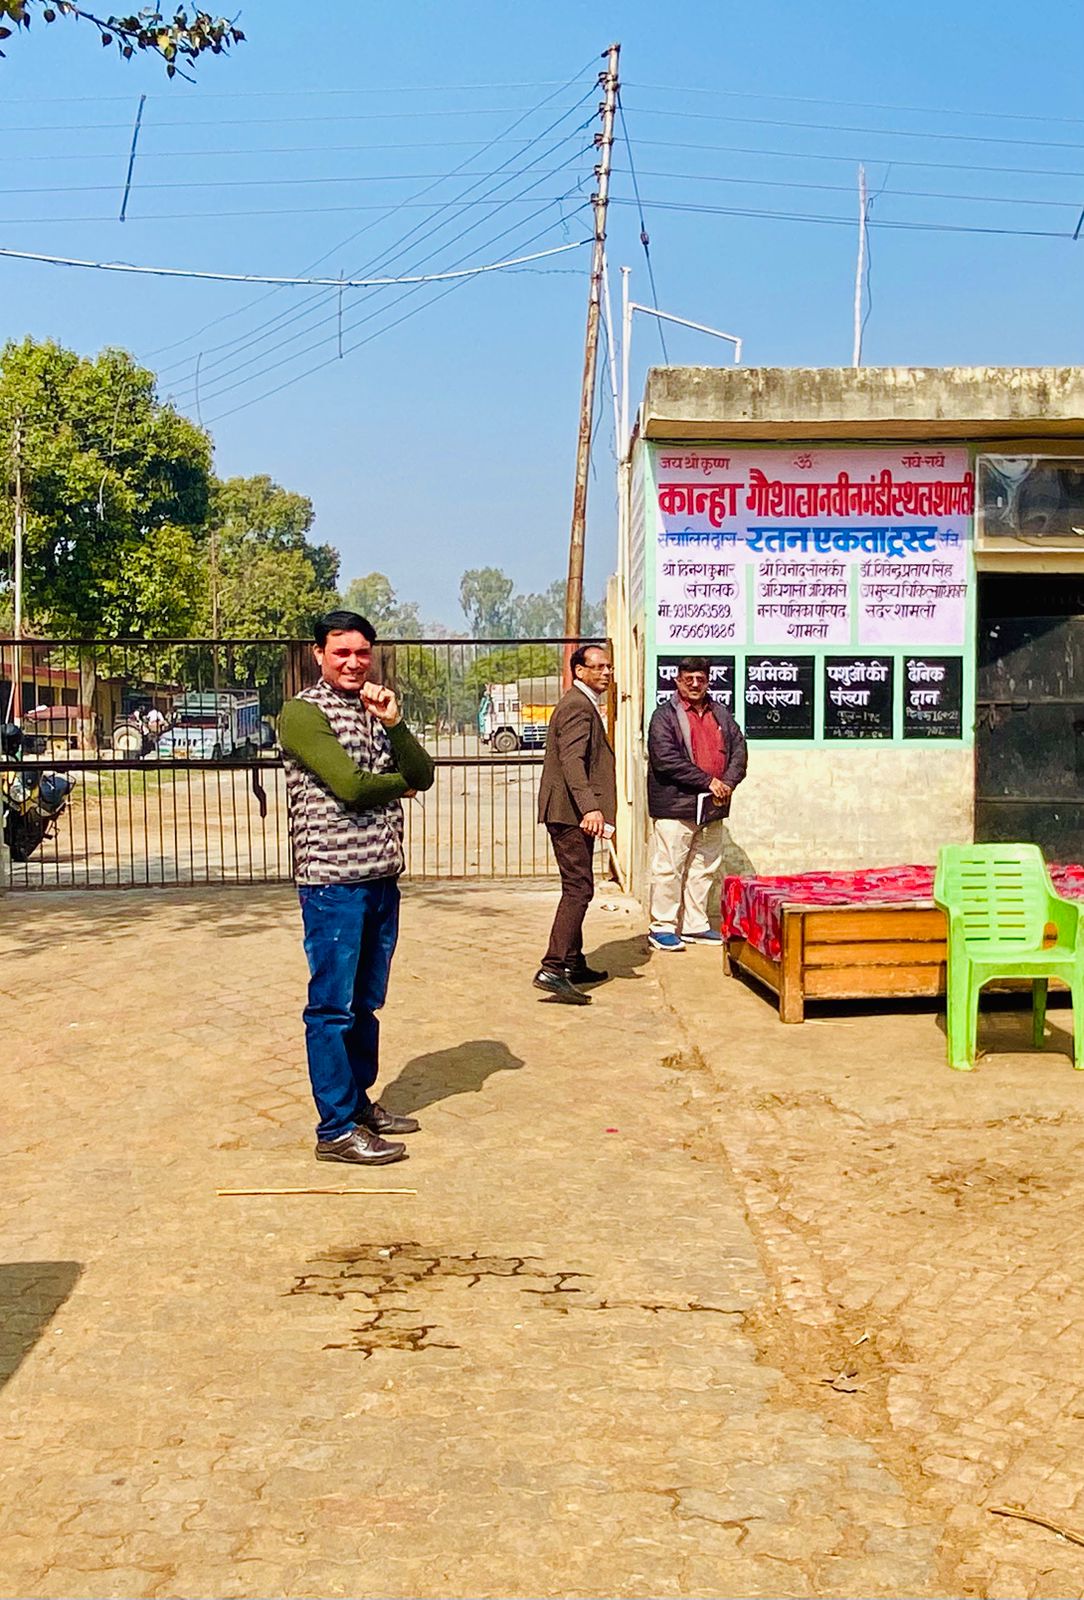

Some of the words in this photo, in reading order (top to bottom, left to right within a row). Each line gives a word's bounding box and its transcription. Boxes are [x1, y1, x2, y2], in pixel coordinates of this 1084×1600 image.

[660, 457, 683, 469] जय
[684, 453, 699, 470] श्री
[700, 457, 731, 476] कृष्ण
[658, 483, 745, 528] कान्हा
[745, 527, 811, 553] रतन
[813, 526, 889, 553] एकता
[887, 526, 938, 558] ट्रस्ट
[663, 559, 676, 576] श्री
[759, 558, 774, 576] श्री
[894, 600, 936, 620] शामली
[787, 619, 829, 639] शामली
[909, 690, 940, 706] दान
